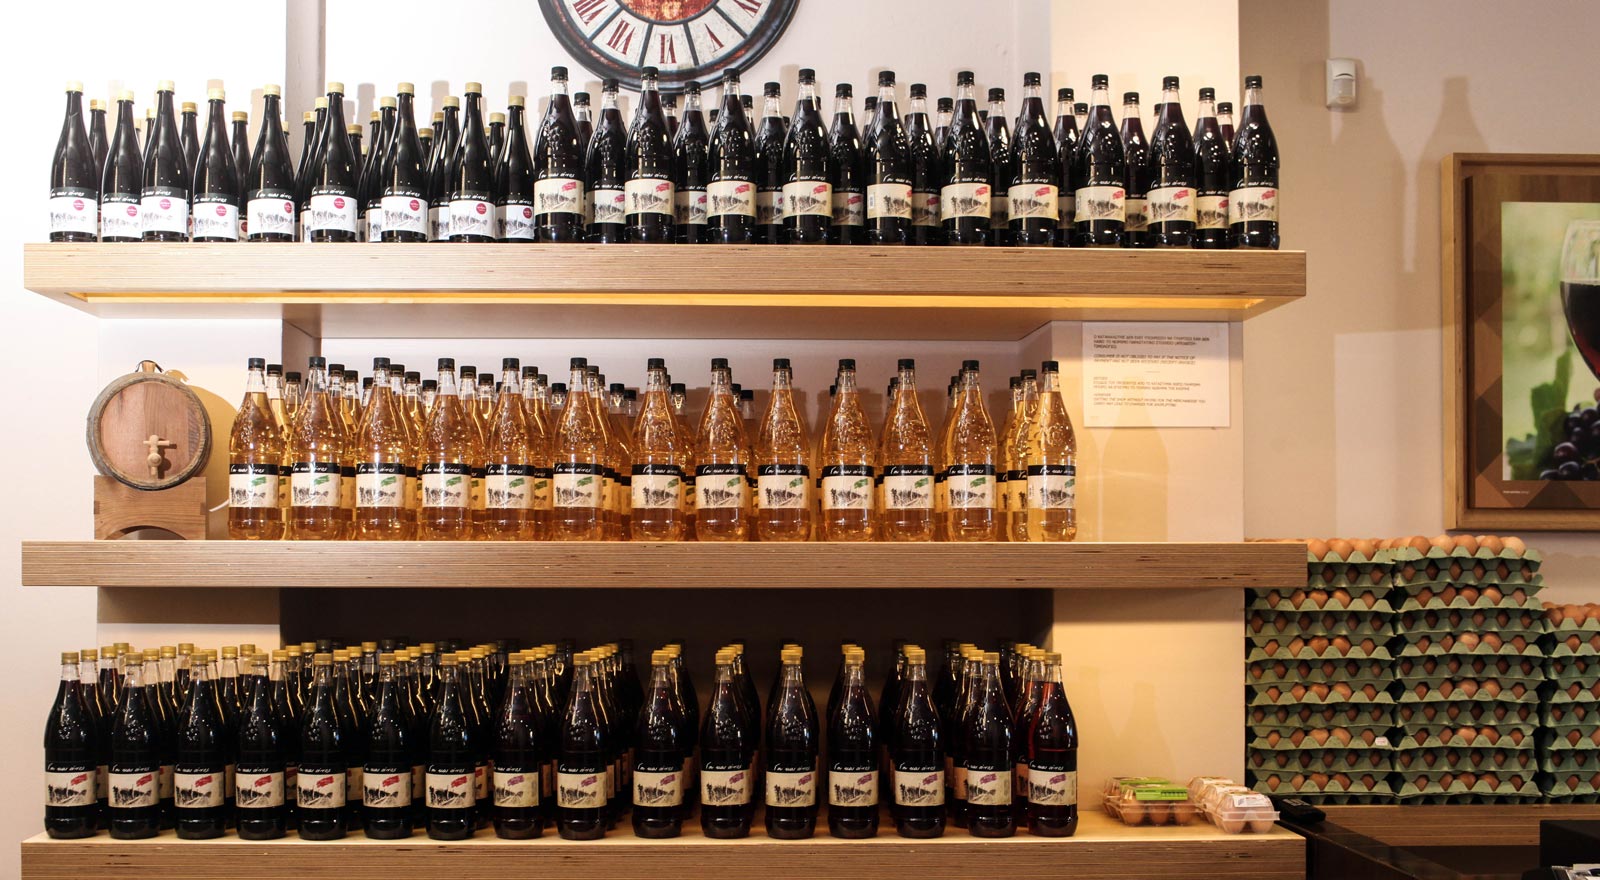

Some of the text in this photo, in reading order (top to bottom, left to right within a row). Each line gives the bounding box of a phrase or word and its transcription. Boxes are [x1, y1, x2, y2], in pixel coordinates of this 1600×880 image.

[606, 17, 636, 56] VII
[659, 33, 677, 65] VI
[704, 22, 725, 53] V
